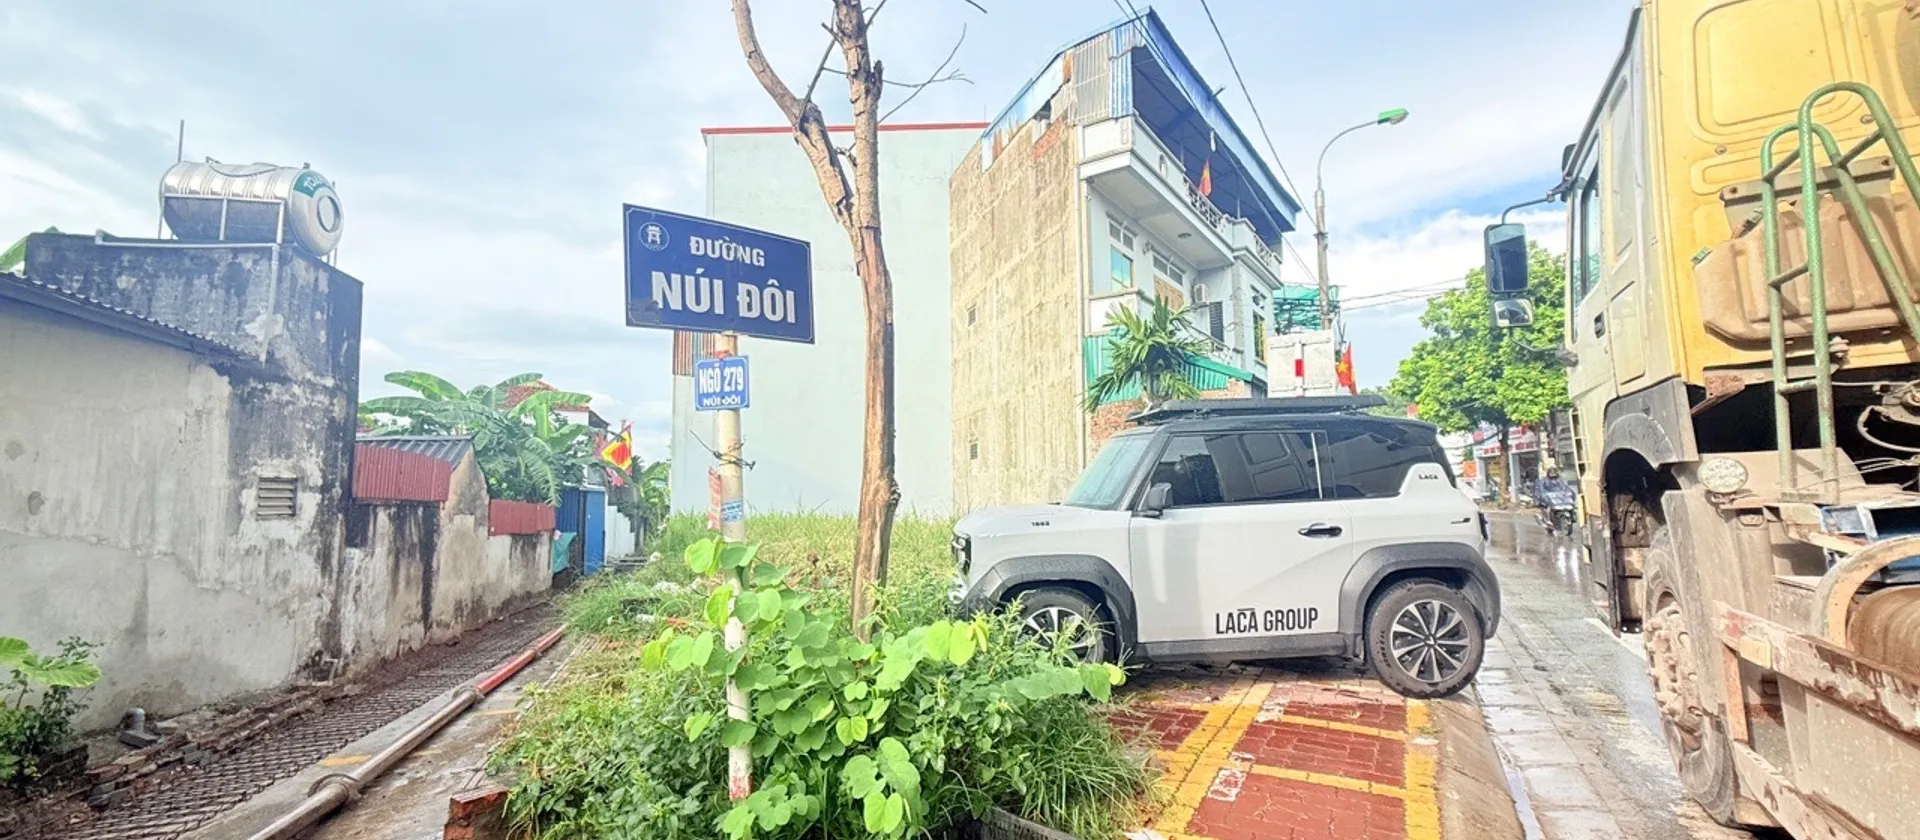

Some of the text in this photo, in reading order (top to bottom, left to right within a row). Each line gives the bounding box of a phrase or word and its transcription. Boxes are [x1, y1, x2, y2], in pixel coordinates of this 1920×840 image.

[689, 235, 765, 267] ĐƯỜNG
[651, 267, 797, 324] NÚI ĐÔI
[699, 362, 744, 394] NGÕ 279
[1264, 607, 1318, 632] GROUP
